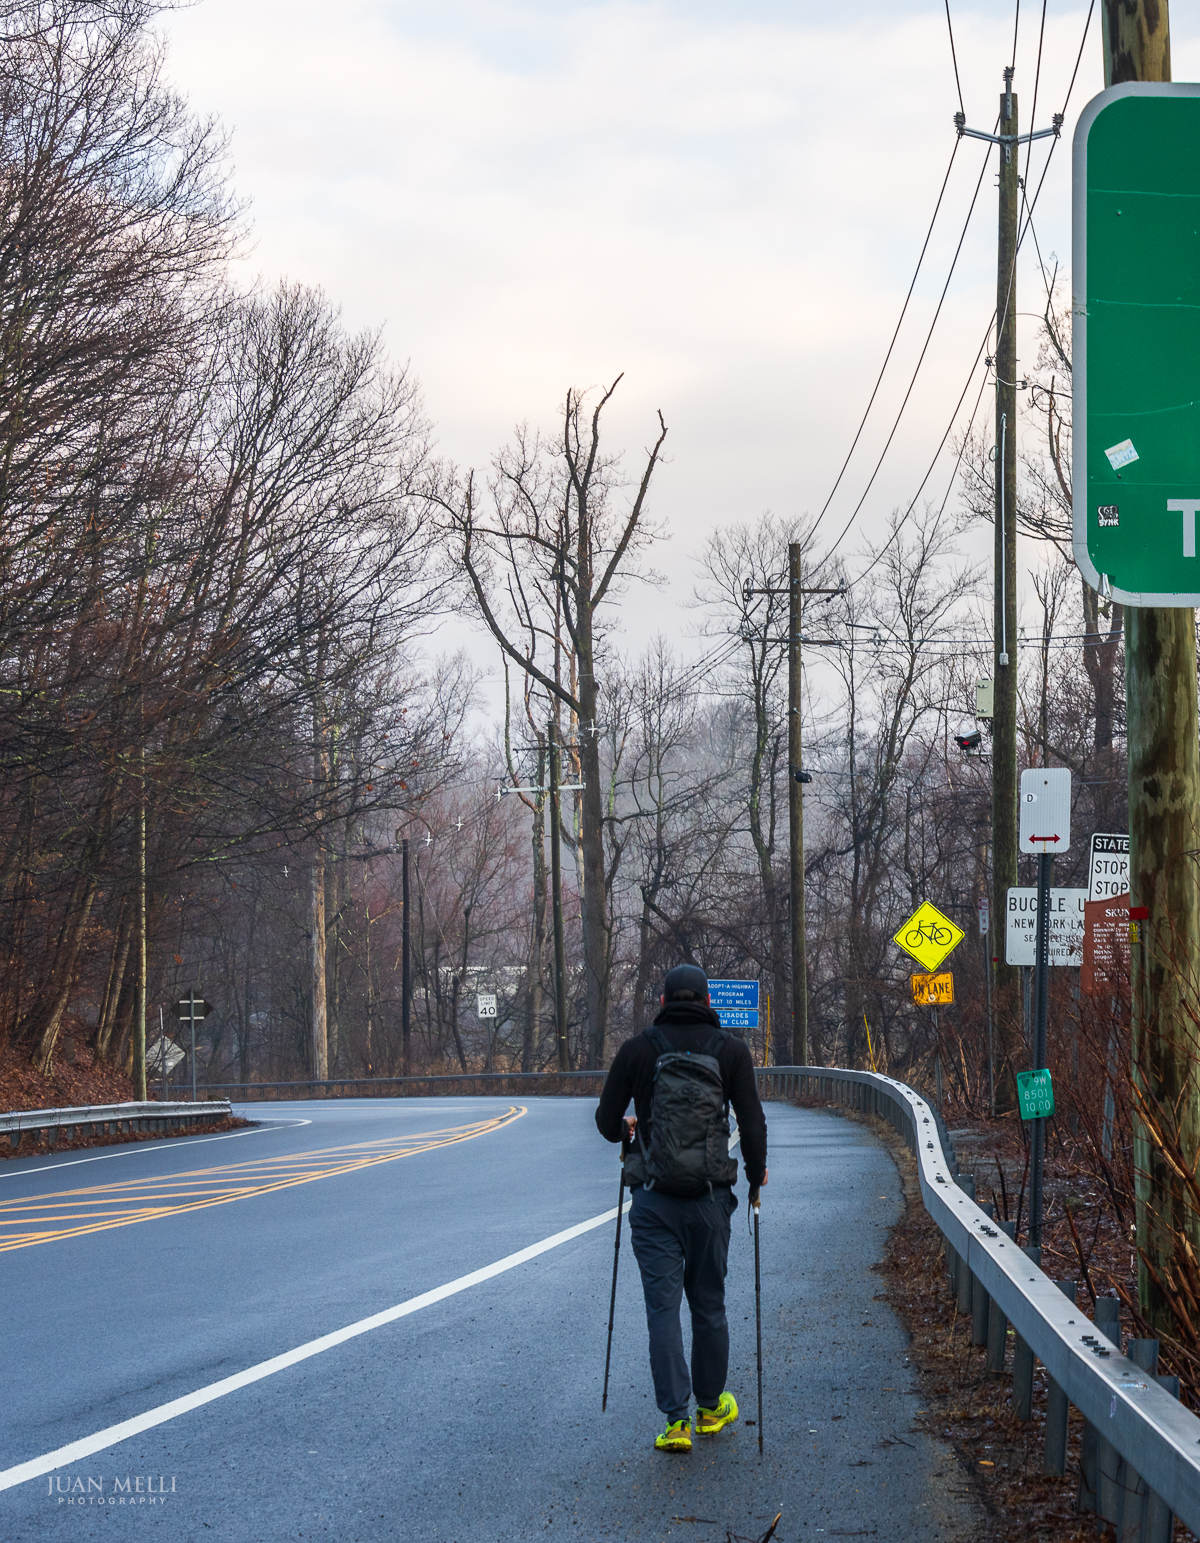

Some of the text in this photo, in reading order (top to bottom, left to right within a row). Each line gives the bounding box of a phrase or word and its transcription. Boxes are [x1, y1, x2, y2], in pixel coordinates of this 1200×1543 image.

[1027, 794, 1033, 802] D
[1095, 838, 1129, 850] STATE
[1095, 860, 1127, 875] STOP
[1095, 881, 1128, 895] STOP
[1009, 897, 1066, 912] BUCLE
[1105, 908, 1130, 918] SKUN
[1014, 918, 1035, 929] NEW
[1048, 919, 1065, 929] ORK
[928, 982, 950, 994] LANE
[480, 1006, 495, 1015] 40
[1033, 1076, 1046, 1086] 9W
[1024, 1088, 1048, 1100] 8501
